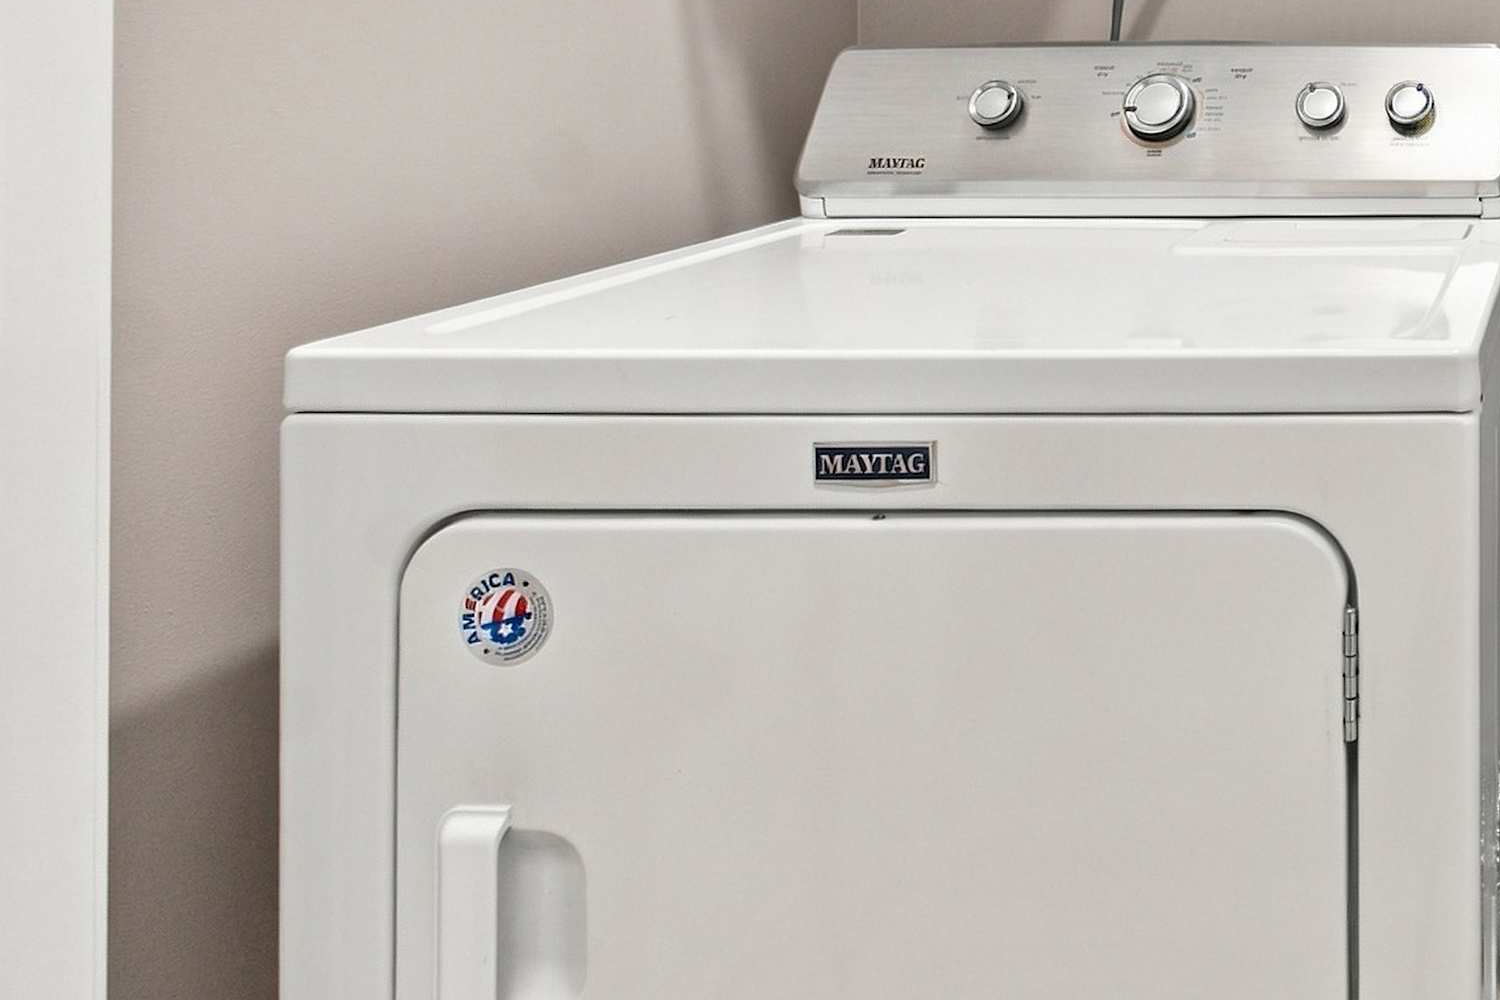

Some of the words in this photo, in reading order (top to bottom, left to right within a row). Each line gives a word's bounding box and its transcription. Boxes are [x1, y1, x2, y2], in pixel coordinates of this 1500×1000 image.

[868, 157, 926, 169] MAYTAG
[819, 453, 927, 475] MAYTAG
[462, 572, 516, 645] AMERICA
